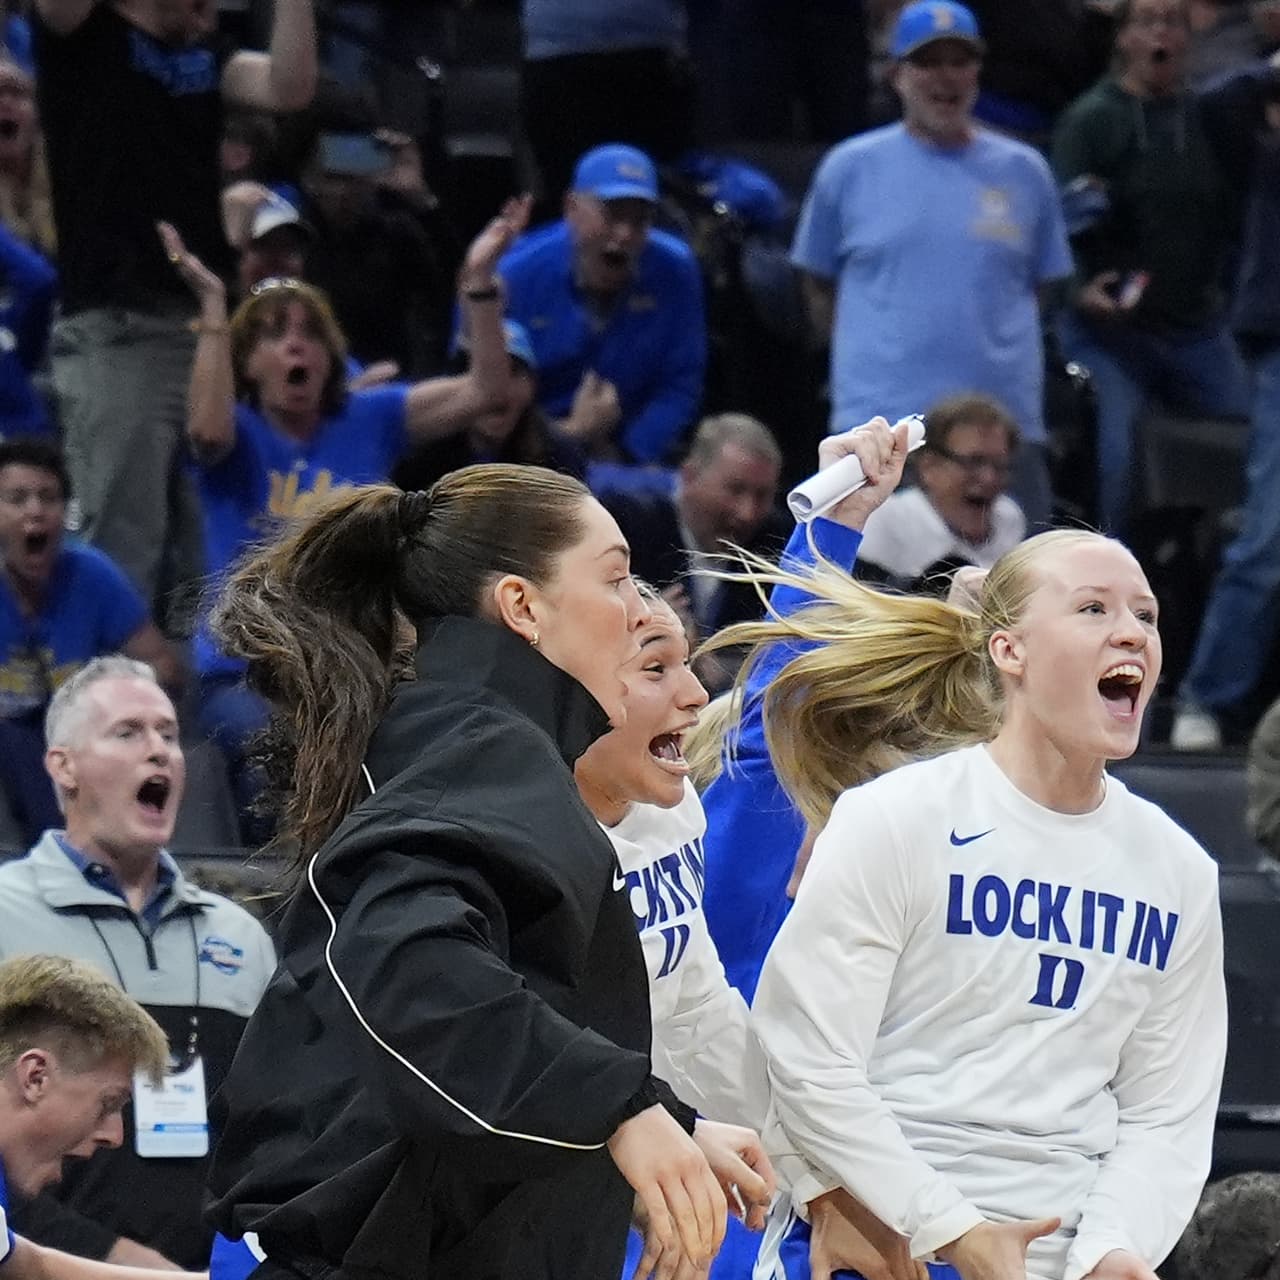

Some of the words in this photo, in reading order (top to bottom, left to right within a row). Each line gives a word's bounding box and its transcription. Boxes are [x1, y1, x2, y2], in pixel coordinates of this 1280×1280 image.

[946, 874, 1072, 945] LOCK
[1079, 889, 1124, 954] IT
[1126, 900, 1179, 972] IN
[1027, 952, 1085, 1010] D
